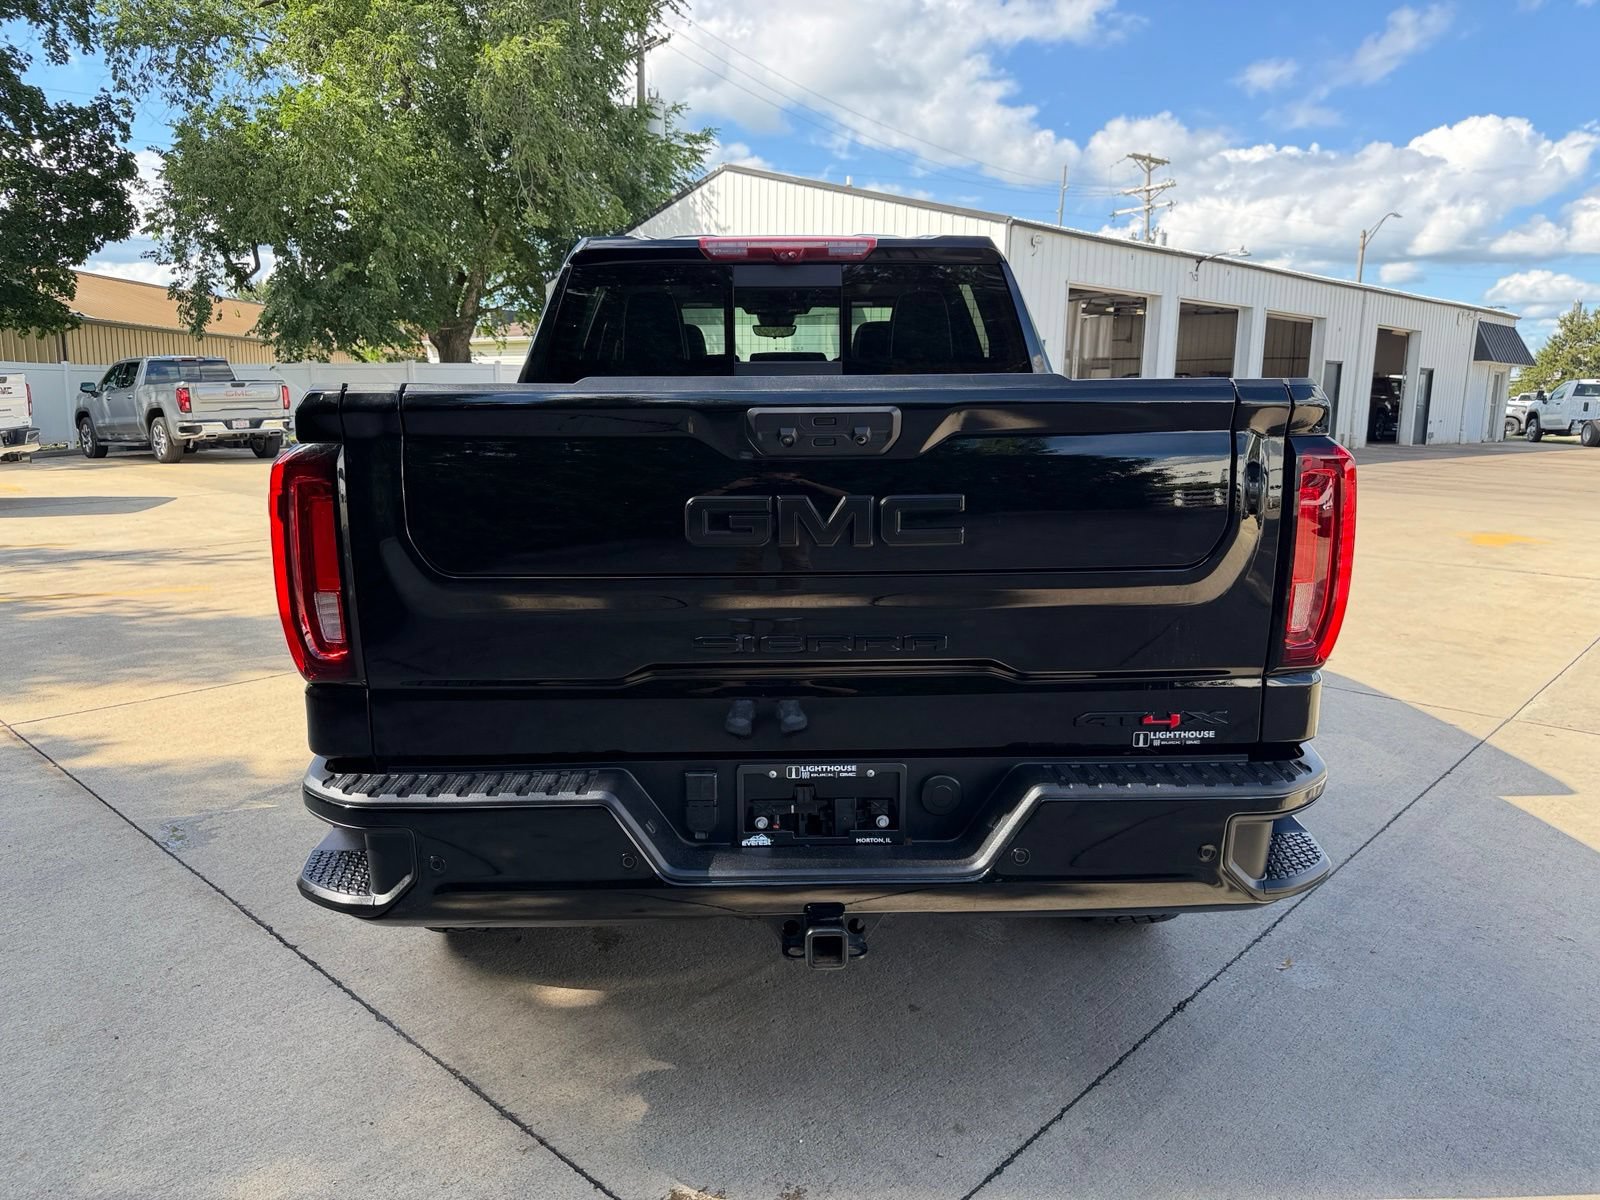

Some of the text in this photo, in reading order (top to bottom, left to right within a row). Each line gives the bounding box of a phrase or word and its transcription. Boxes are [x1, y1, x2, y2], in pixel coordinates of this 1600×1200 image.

[225, 390, 252, 398] GMC
[685, 494, 965, 547] GMC
[693, 633, 948, 652] SIERRA
[1150, 731, 1215, 739] LIGHTHOUSE
